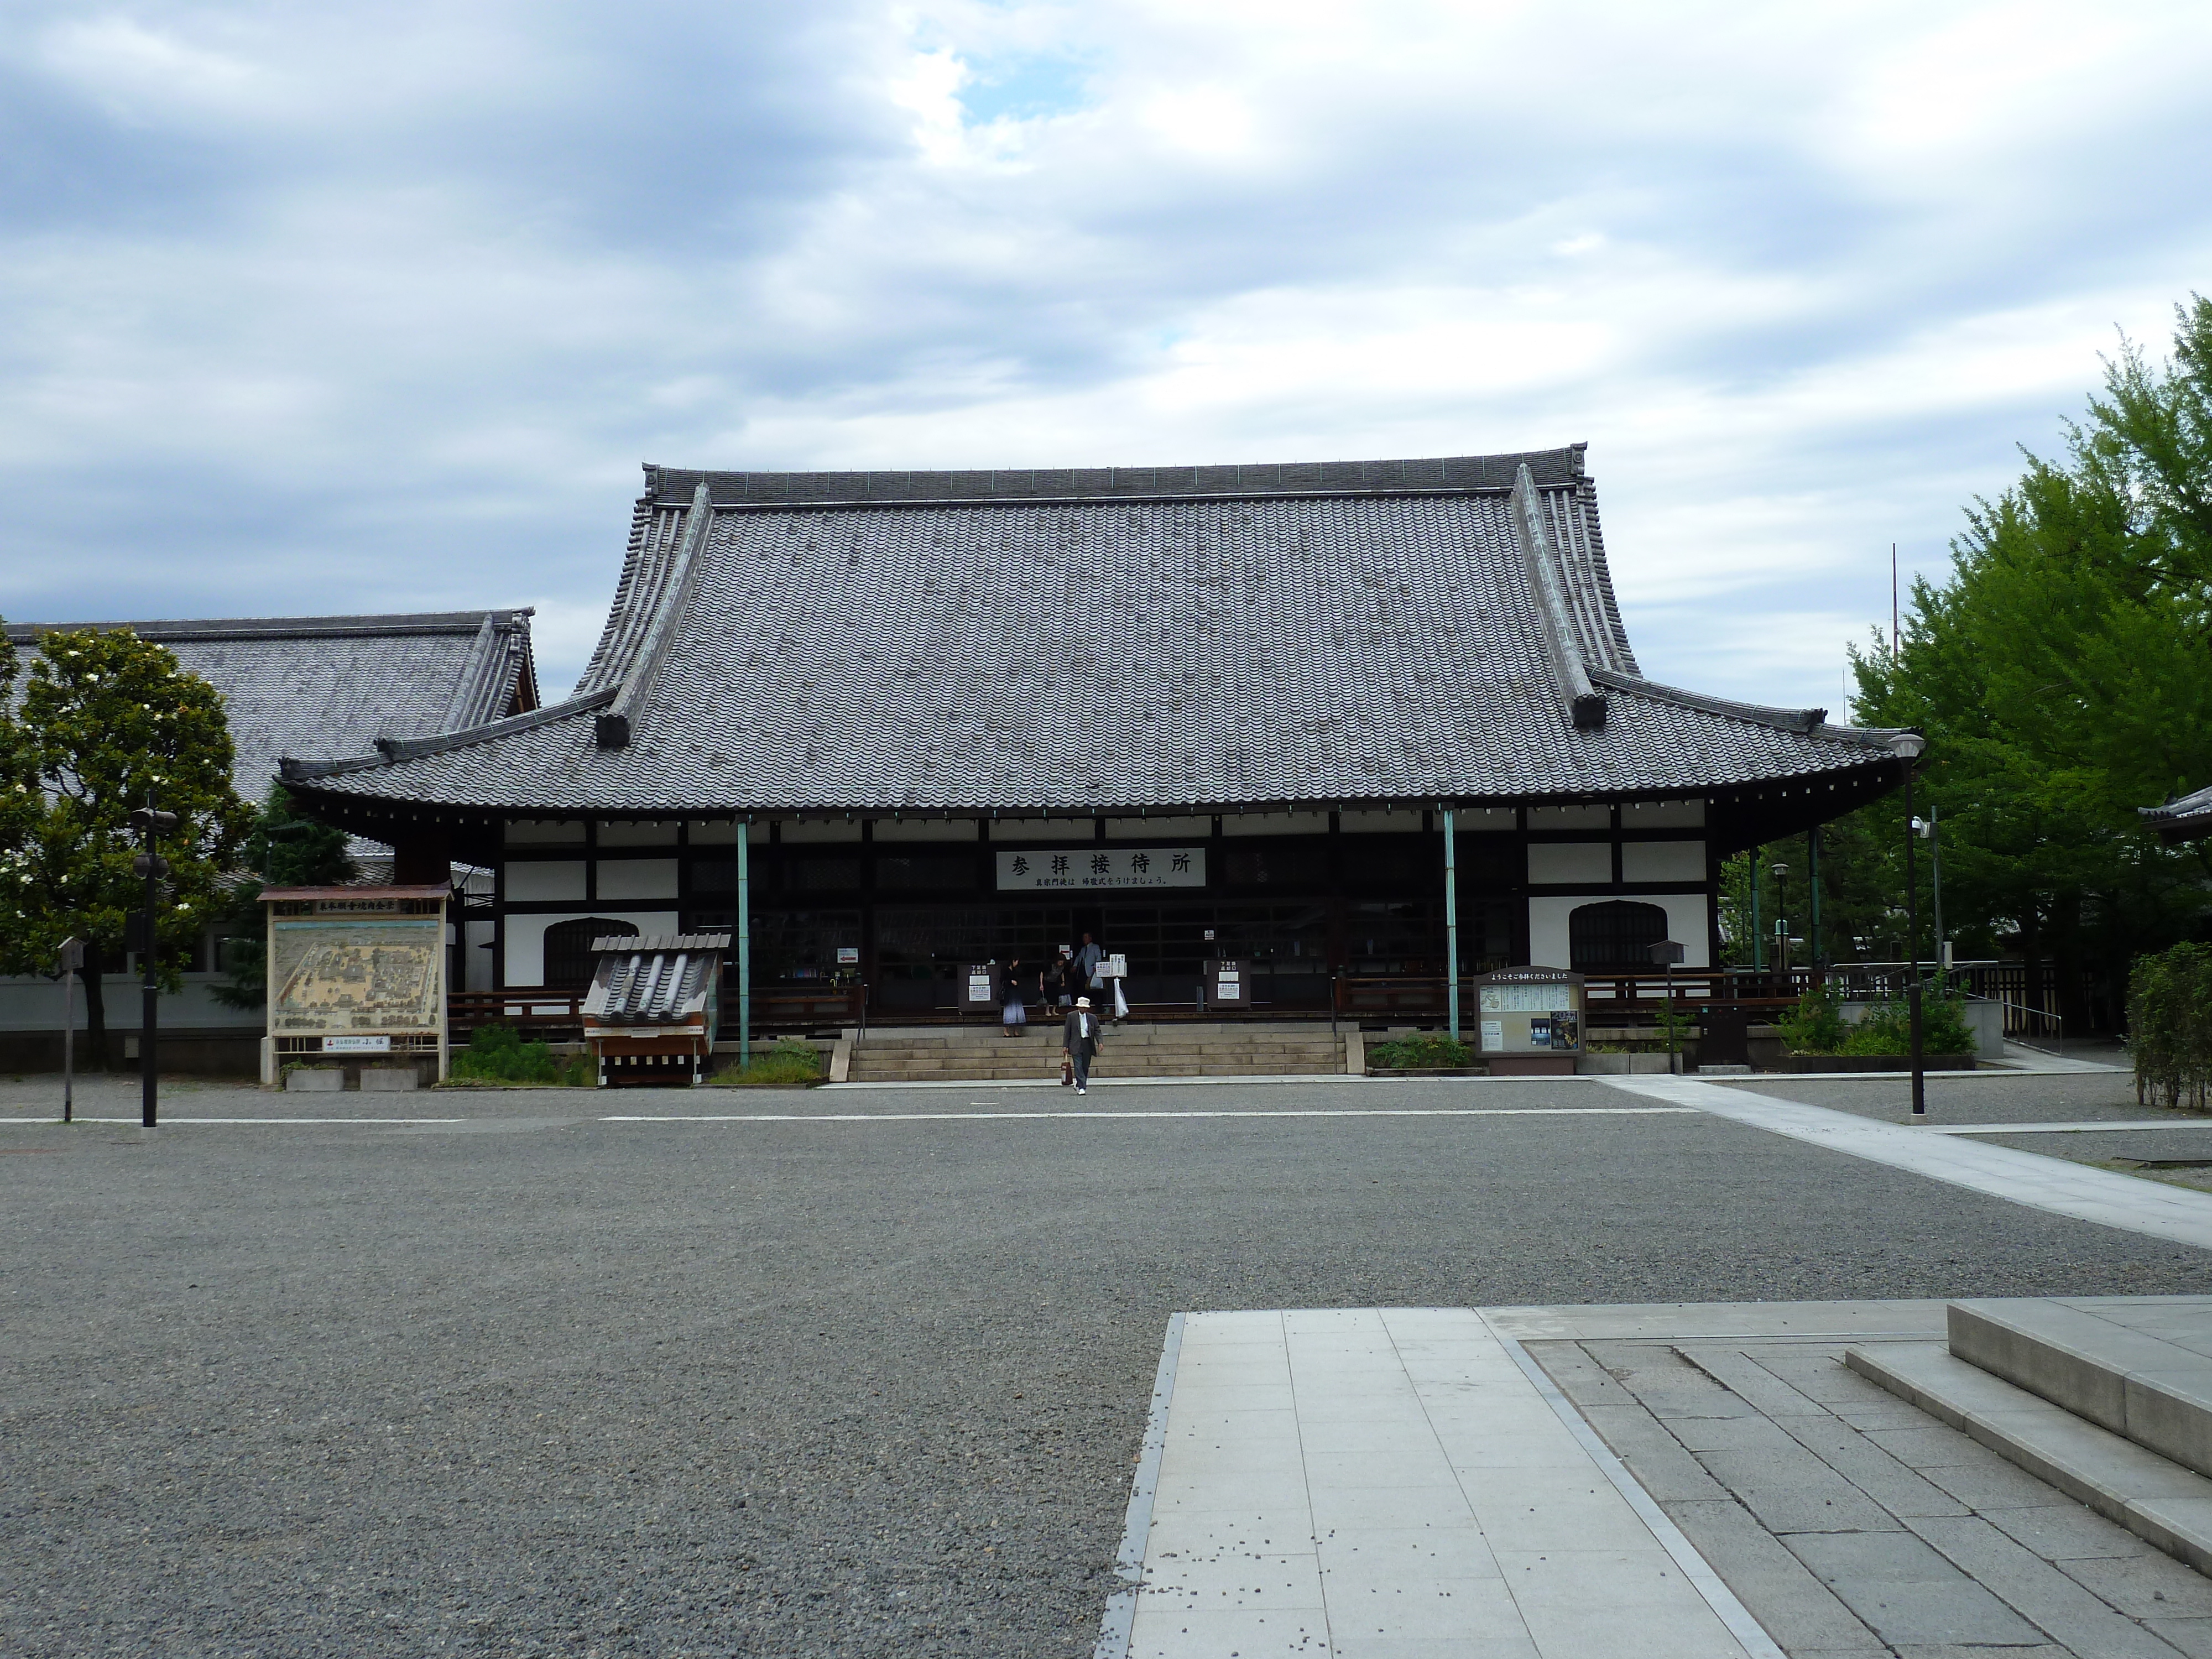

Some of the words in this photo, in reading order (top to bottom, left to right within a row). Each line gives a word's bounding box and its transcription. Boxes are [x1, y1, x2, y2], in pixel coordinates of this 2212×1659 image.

[1011, 853, 1191, 876] 参拝接待所
